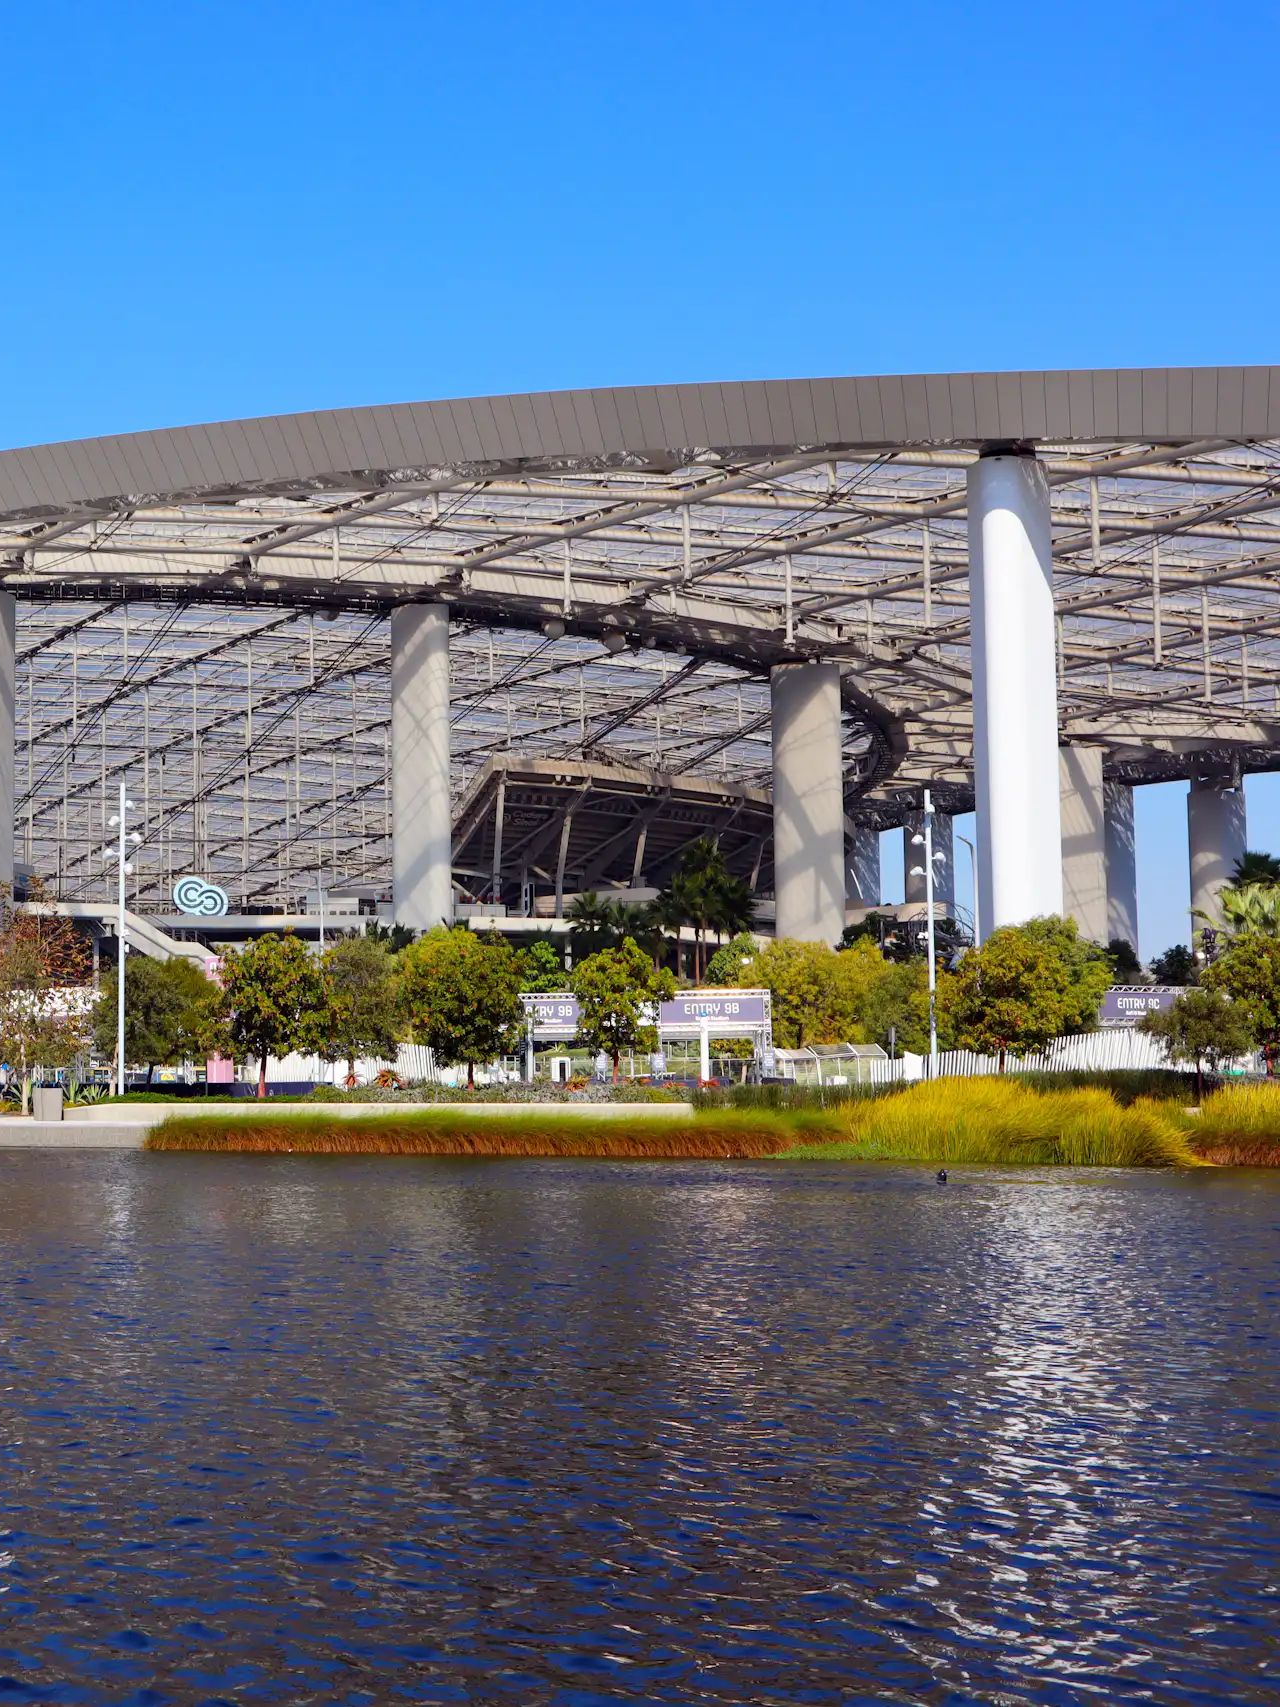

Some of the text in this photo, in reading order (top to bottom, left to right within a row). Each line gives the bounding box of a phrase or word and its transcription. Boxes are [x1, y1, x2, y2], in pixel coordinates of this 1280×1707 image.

[684, 1003, 740, 1014] ENTRY 9B
[1117, 998, 1160, 1009] ENTRY 9C
[558, 1005, 573, 1016] 9B
